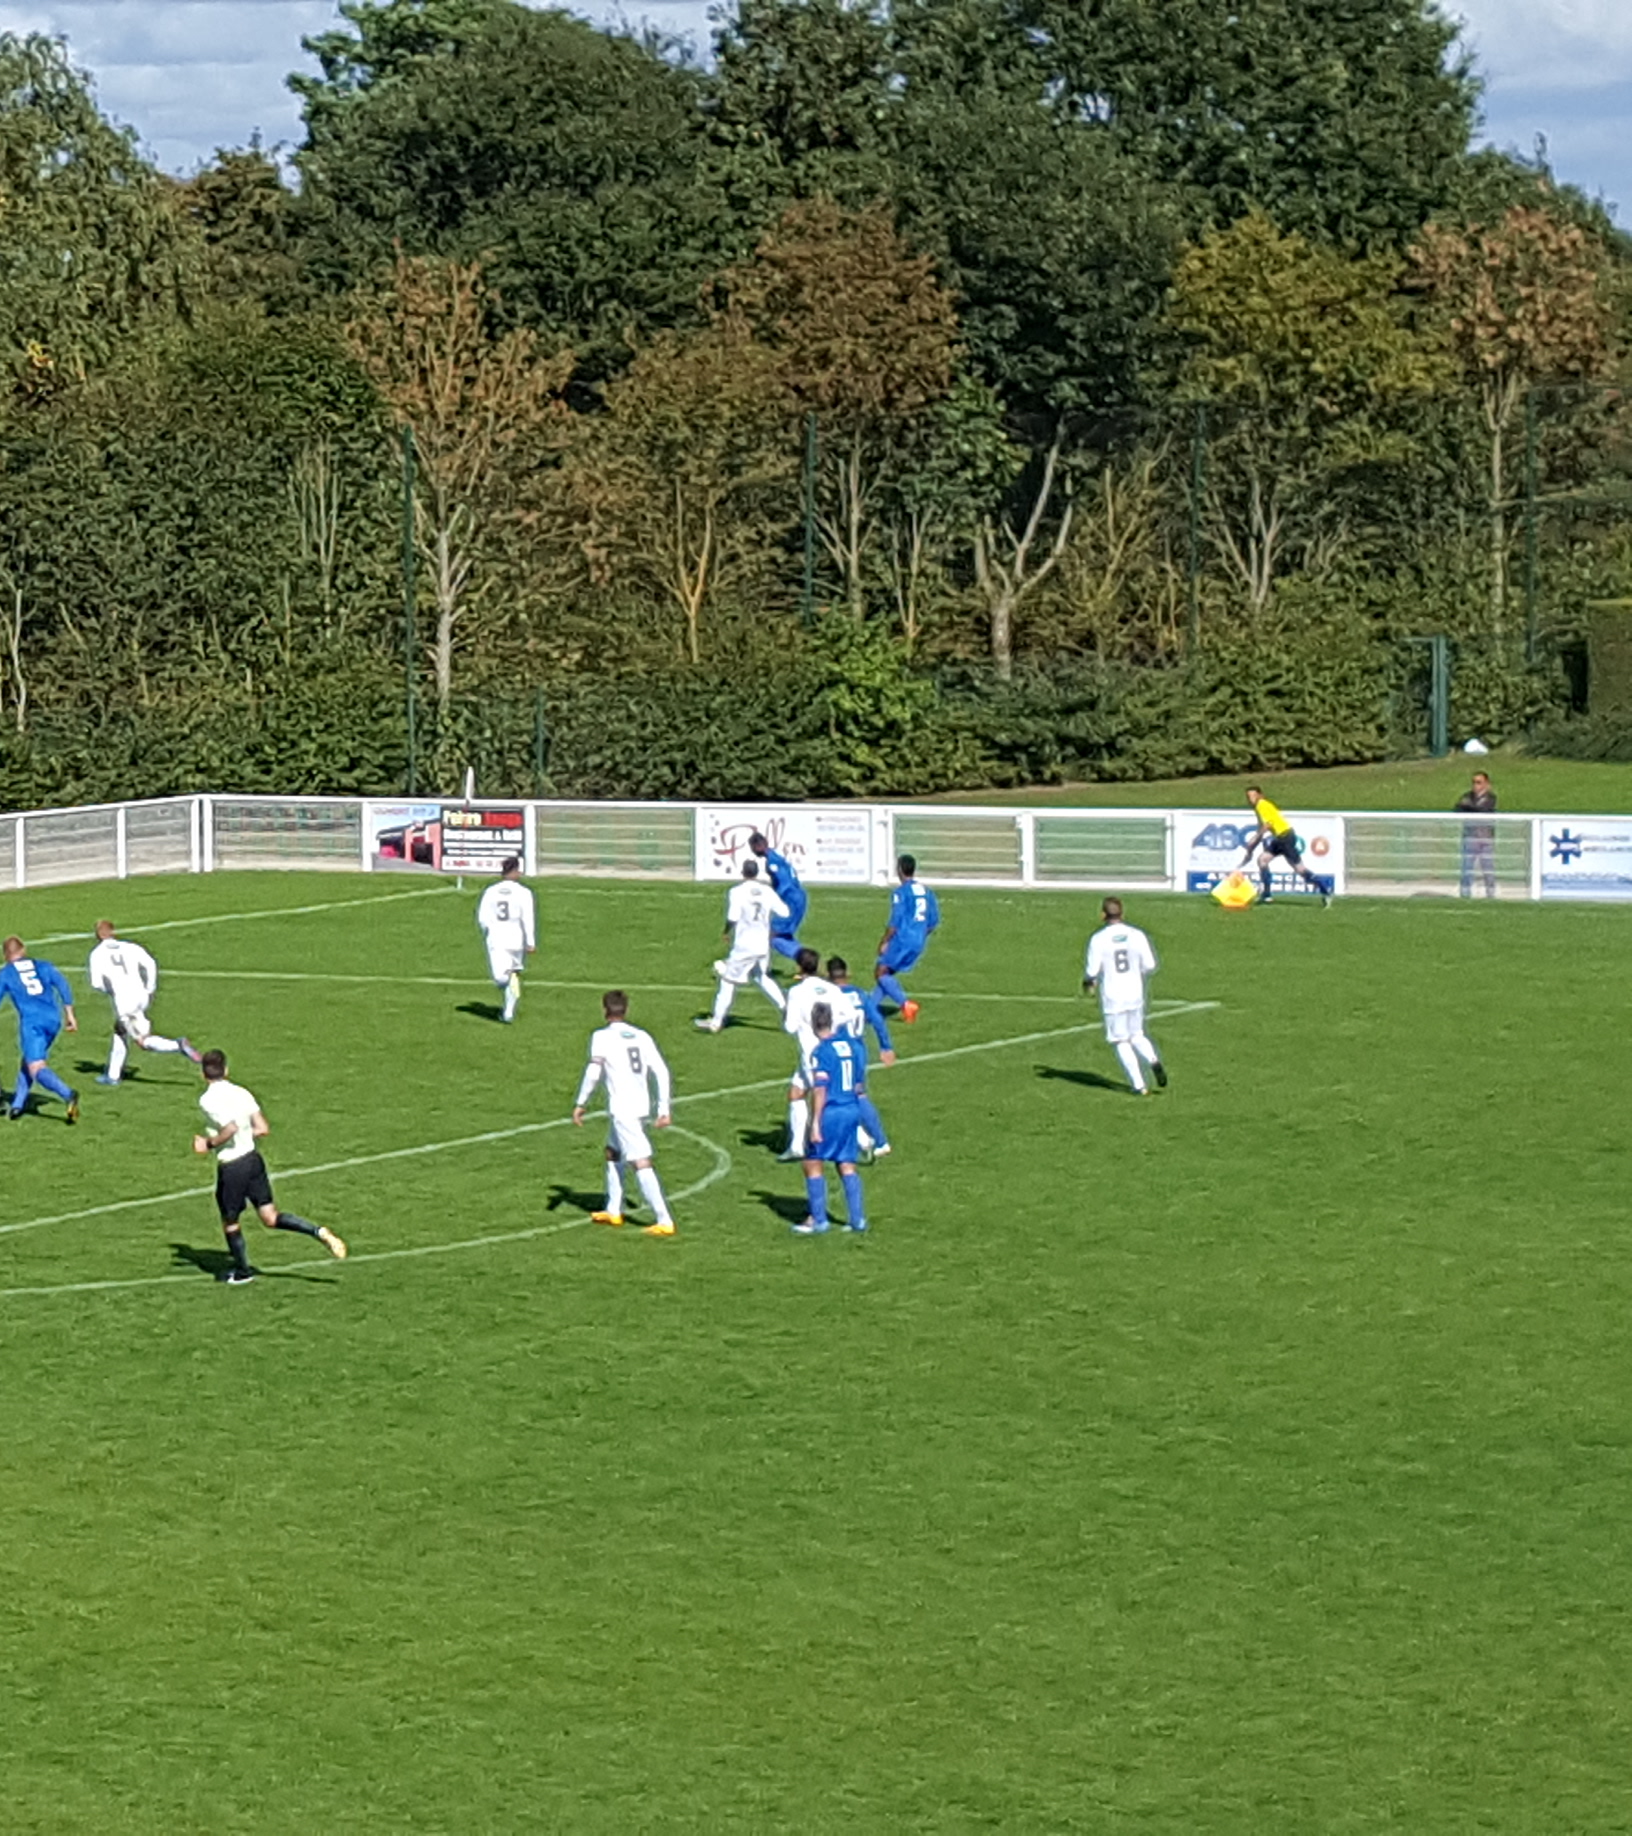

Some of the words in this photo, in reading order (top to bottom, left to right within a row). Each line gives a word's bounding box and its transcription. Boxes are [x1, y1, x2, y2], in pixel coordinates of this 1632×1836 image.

[714, 817, 806, 868] Pllen
[496, 900, 510, 921] 3
[110, 954, 128, 975] 4
[1114, 949, 1130, 973] 6
[19, 971, 44, 996] 5
[627, 1046, 643, 1074] 8
